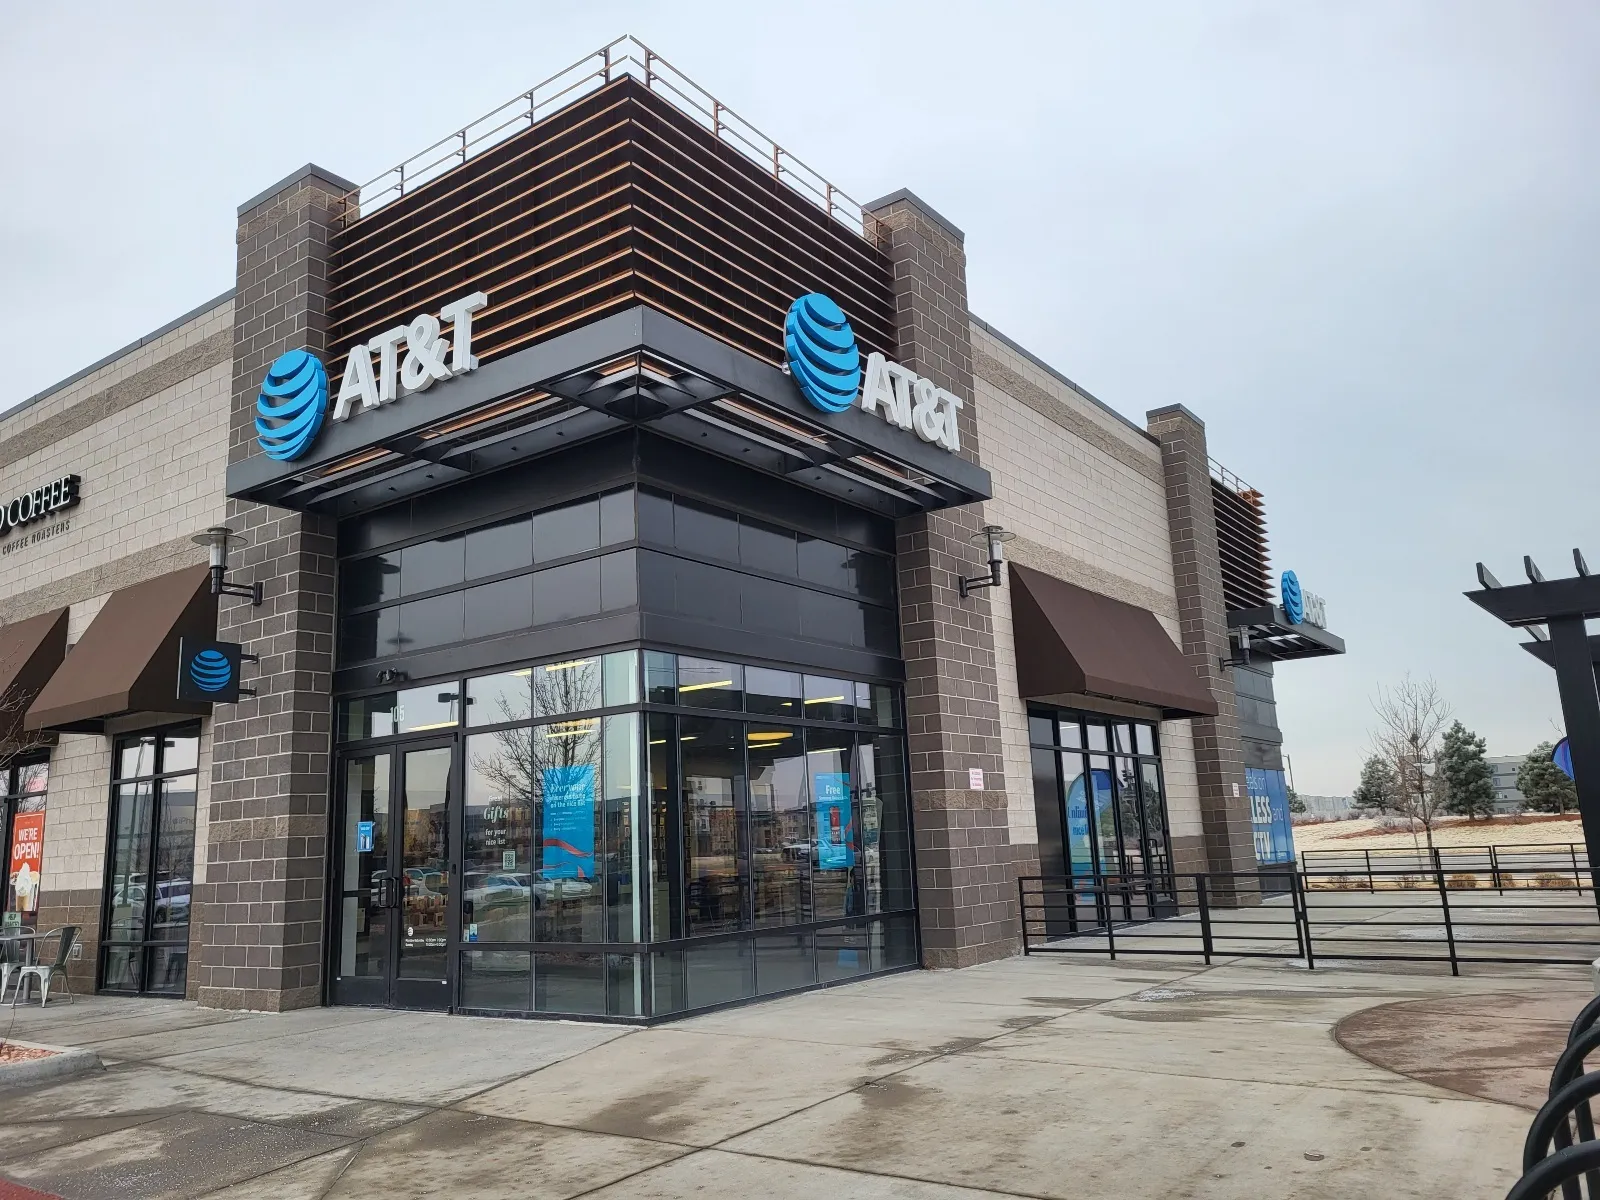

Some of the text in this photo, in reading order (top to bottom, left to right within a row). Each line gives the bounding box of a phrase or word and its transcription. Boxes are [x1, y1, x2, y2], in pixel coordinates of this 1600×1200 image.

[333, 291, 488, 421] AT&T
[861, 351, 963, 452] AT&T
[7, 474, 76, 527] COFFEE
[2, 520, 71, 555] COFFEE ROASTERS
[1302, 589, 1327, 629] AT&T
[390, 704, 405, 723] 105
[825, 784, 841, 795] Free
[483, 806, 509, 824] Gifts
[1249, 796, 1273, 824] LESS
[18, 827, 38, 842] WE'RE
[485, 828, 506, 837] for your
[497, 837, 506, 846] list
[14, 842, 39, 860] OPEN!
[1253, 831, 1271, 861] CTV
